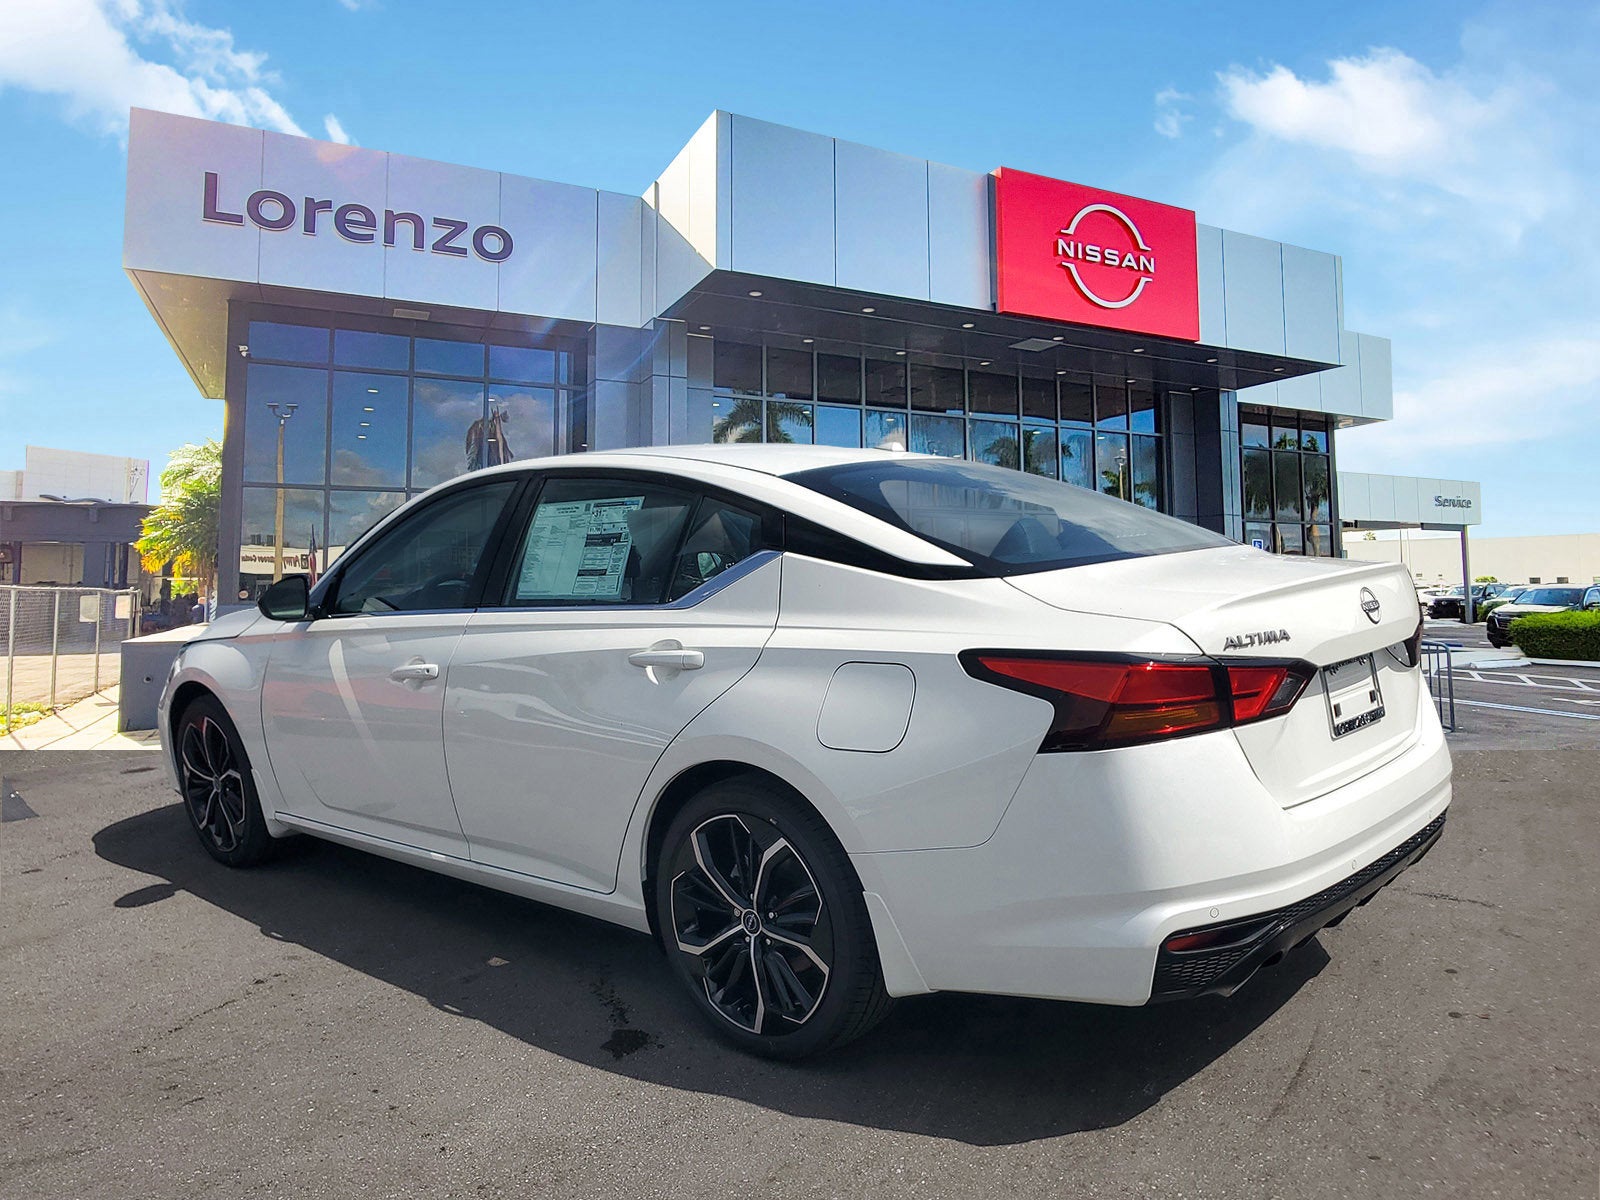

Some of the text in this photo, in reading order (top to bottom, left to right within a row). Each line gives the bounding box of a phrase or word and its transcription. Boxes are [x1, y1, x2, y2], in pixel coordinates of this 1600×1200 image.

[203, 171, 514, 263] Lorenzo
[1058, 238, 1155, 273] NISSAN
[1434, 495, 1472, 508] Service
[1223, 629, 1291, 652] ALTIMA
